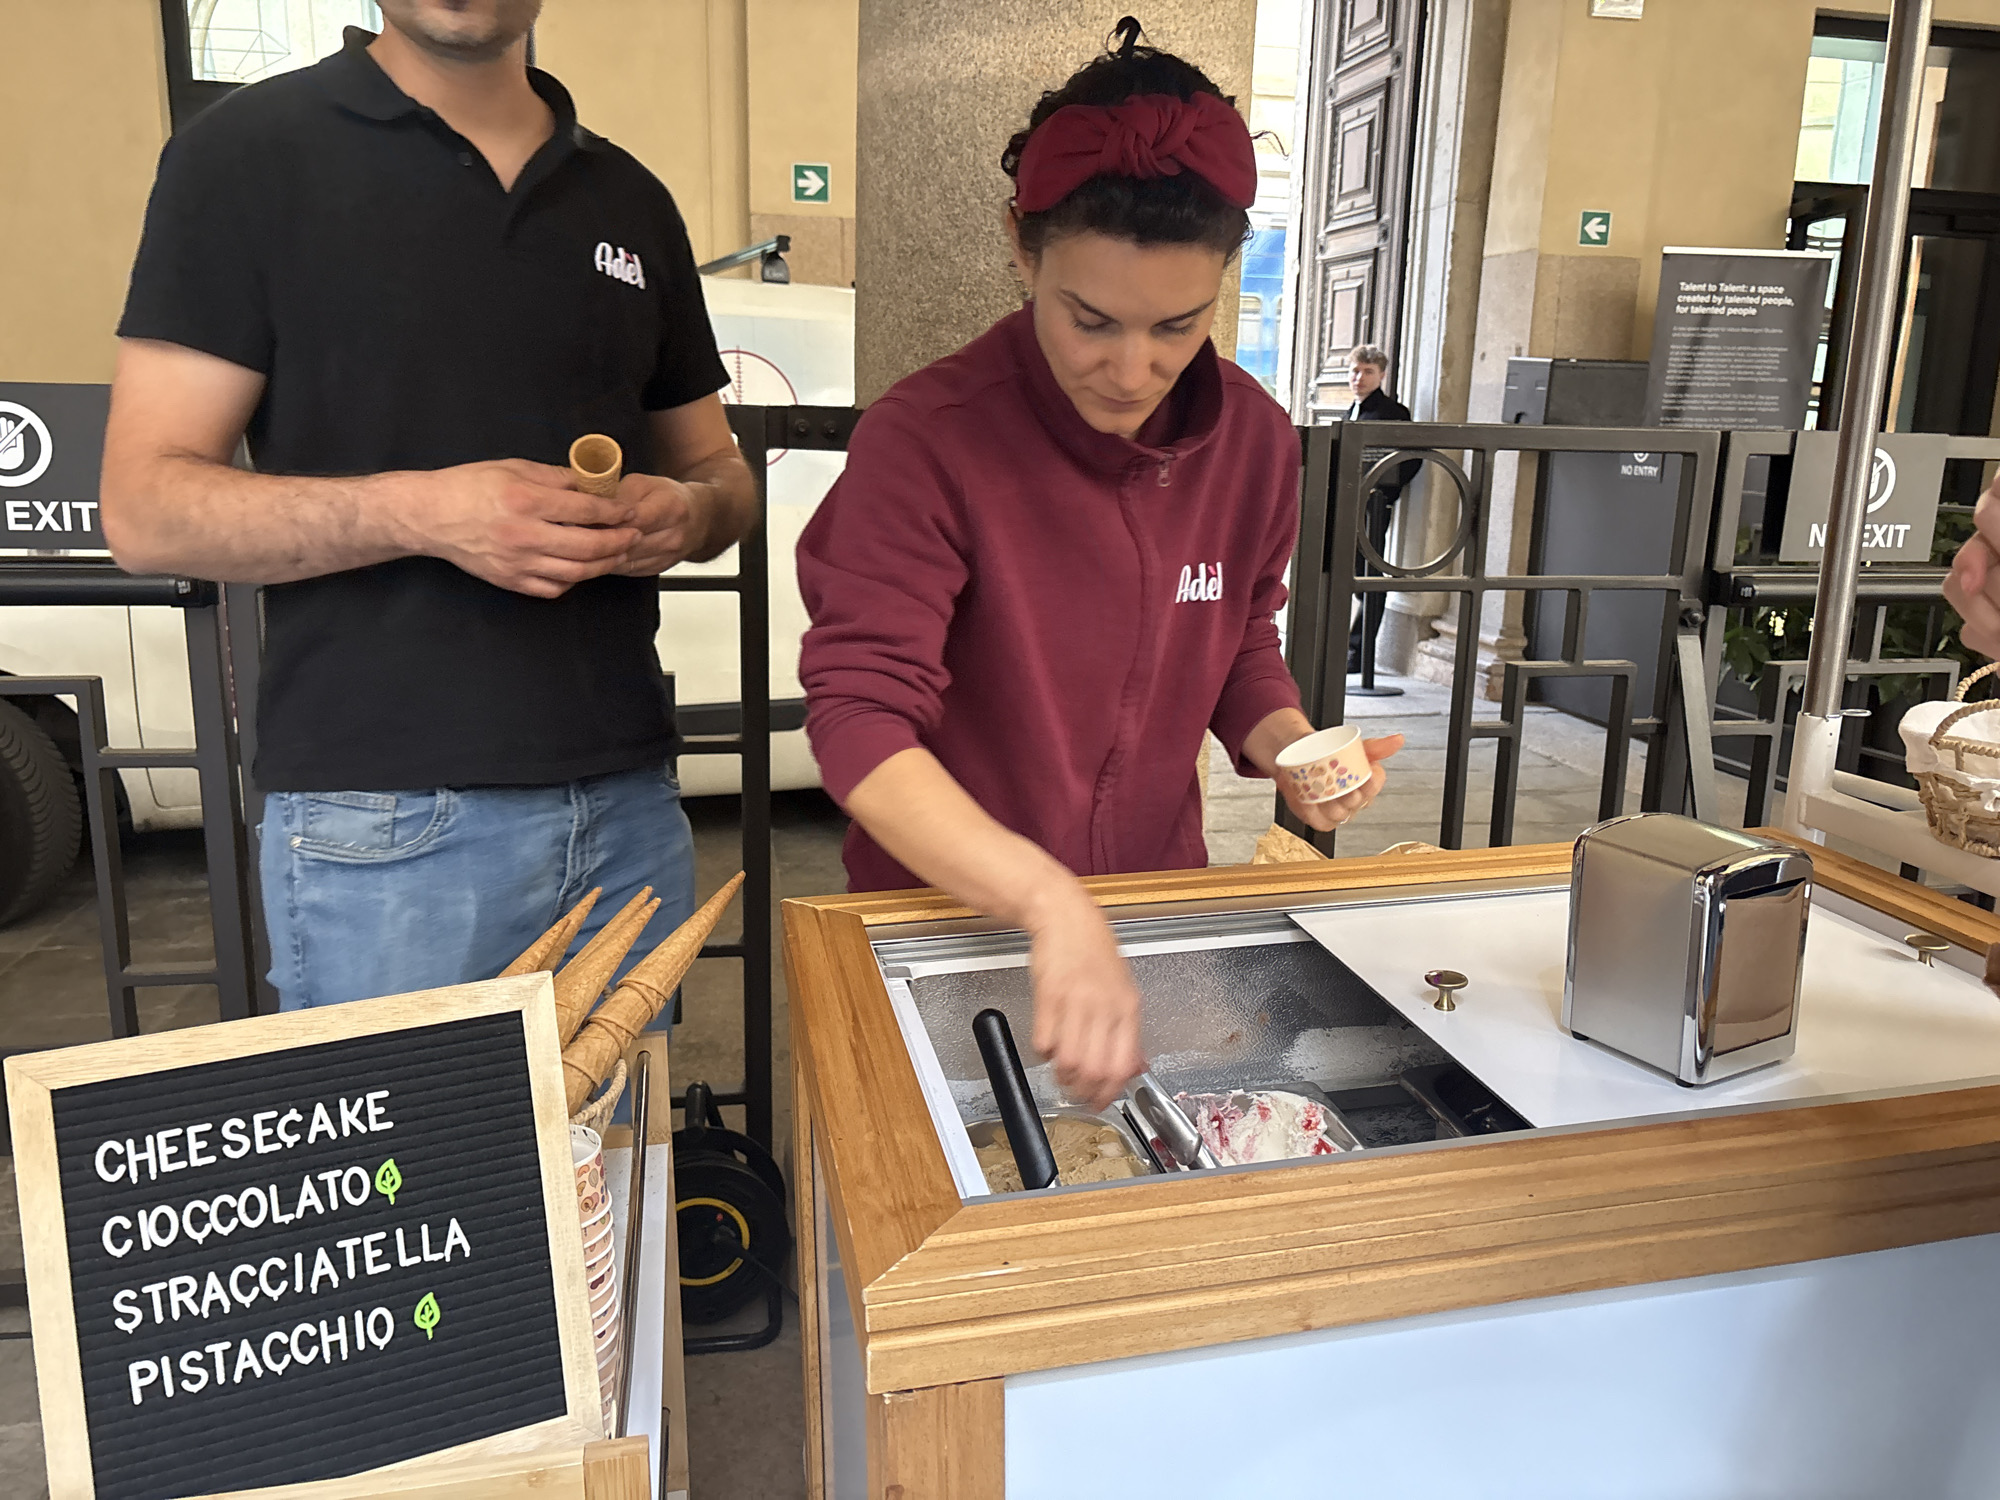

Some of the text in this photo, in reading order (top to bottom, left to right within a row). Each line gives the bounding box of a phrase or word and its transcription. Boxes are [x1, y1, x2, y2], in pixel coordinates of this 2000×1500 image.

[1677, 294, 1795, 307] created by talented people,
[1679, 282, 1785, 296] Talent to Talent: a space
[1675, 304, 1757, 317] for talented people
[1621, 464, 1659, 477] NO ENTRY
[5, 500, 99, 532] EXIT
[1808, 523, 1828, 548] N
[1175, 561, 1223, 604] Adèl
[94, 1089, 394, 1185] CHEESECAKE
[102, 1165, 371, 1258] CIOCCOLATO
[112, 1217, 471, 1334] STRACCIATELLA
[128, 1306, 395, 1406] PISTACCHIO
